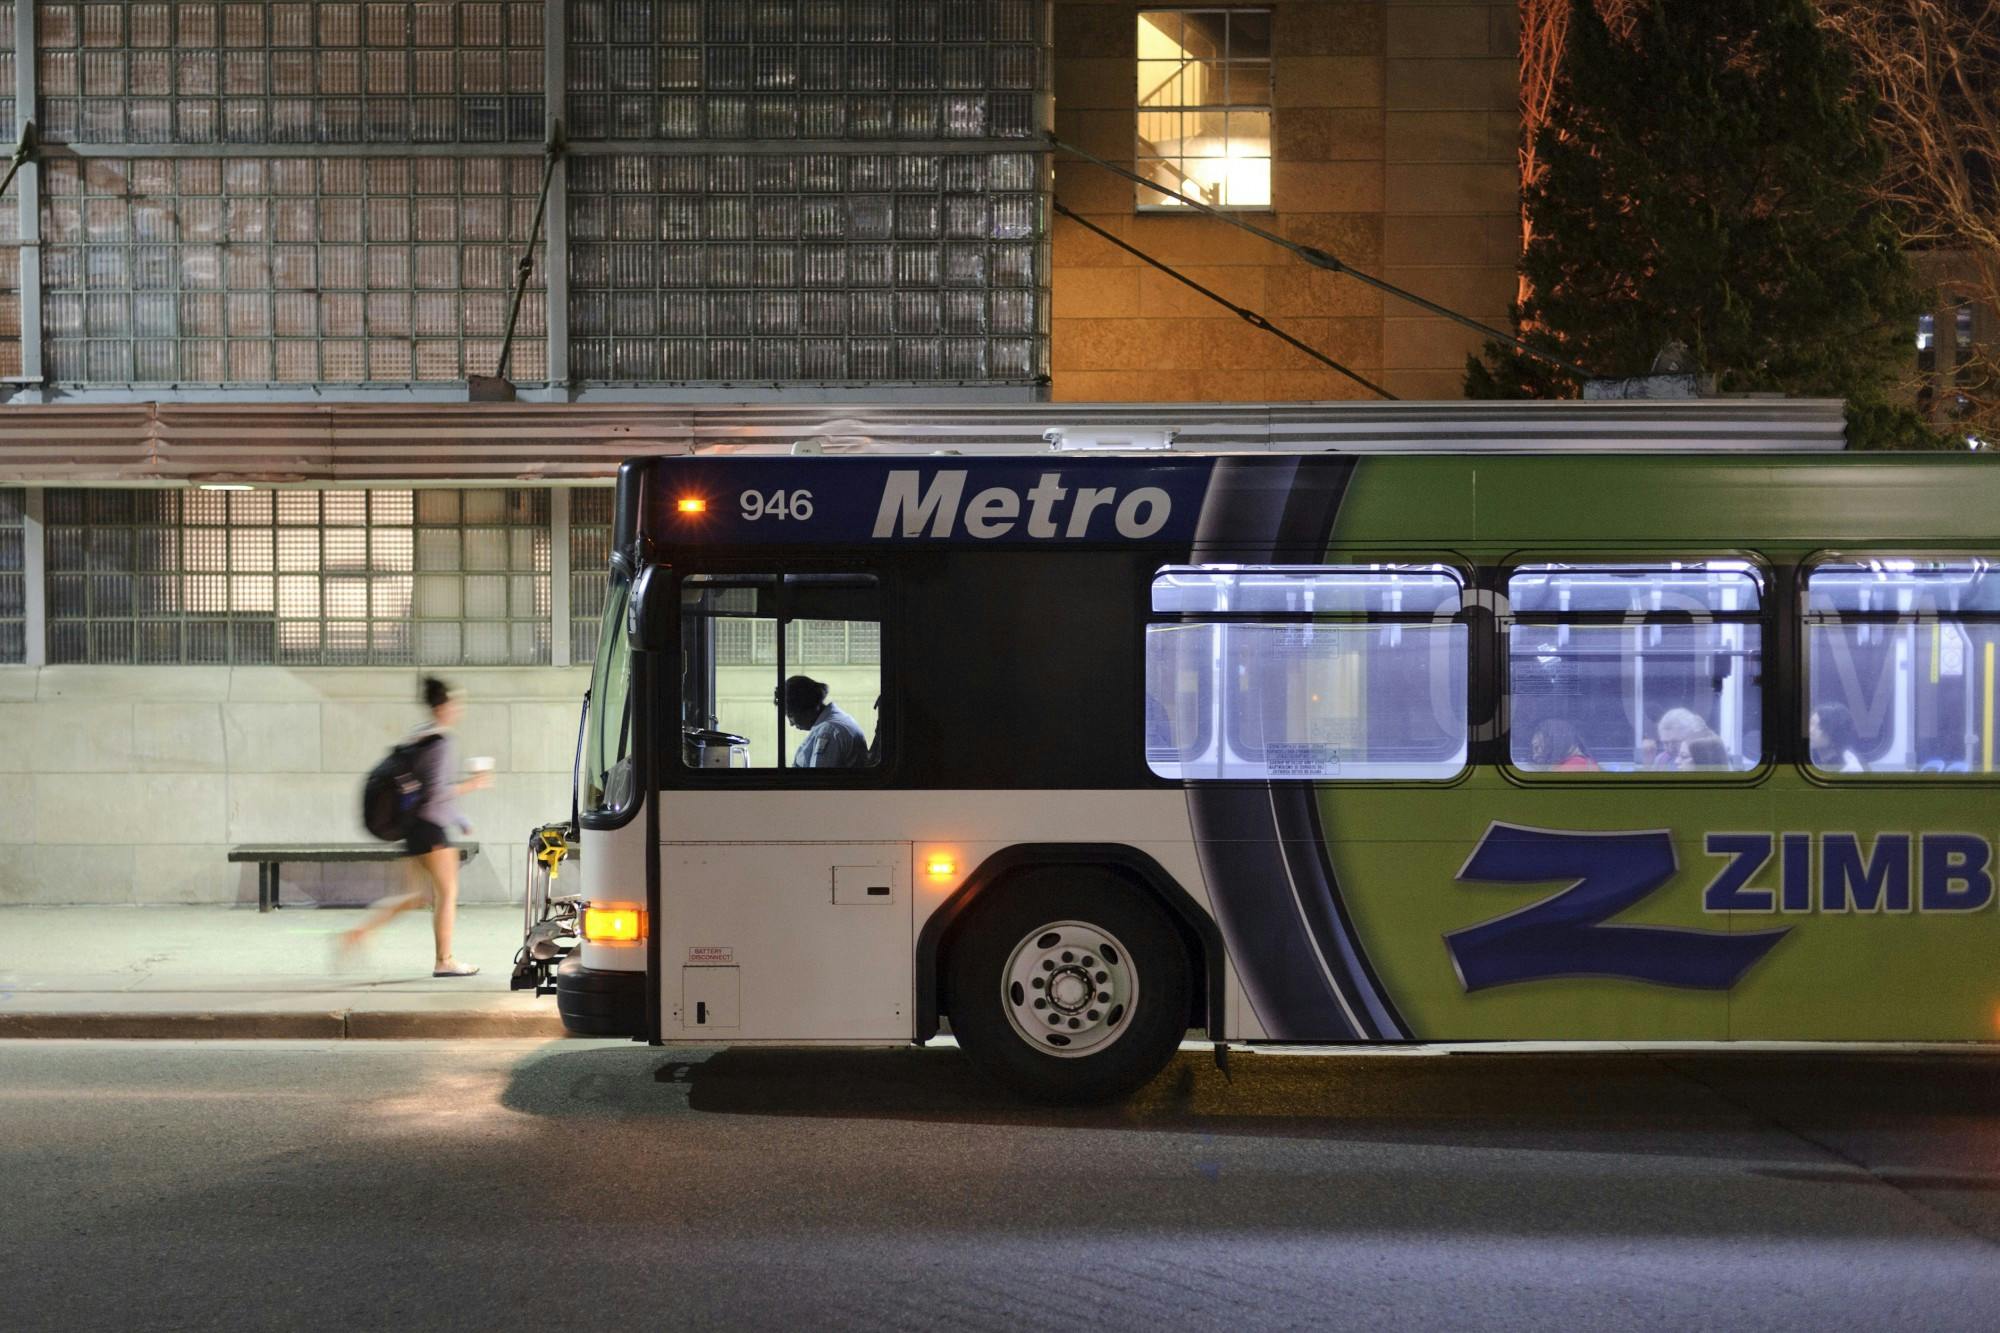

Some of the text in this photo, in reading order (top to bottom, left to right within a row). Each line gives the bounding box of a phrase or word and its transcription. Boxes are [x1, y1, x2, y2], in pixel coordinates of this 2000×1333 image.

[740, 489, 814, 521] 946
[872, 470, 1171, 539] Metro
[1703, 832, 2000, 913] ZIMB
